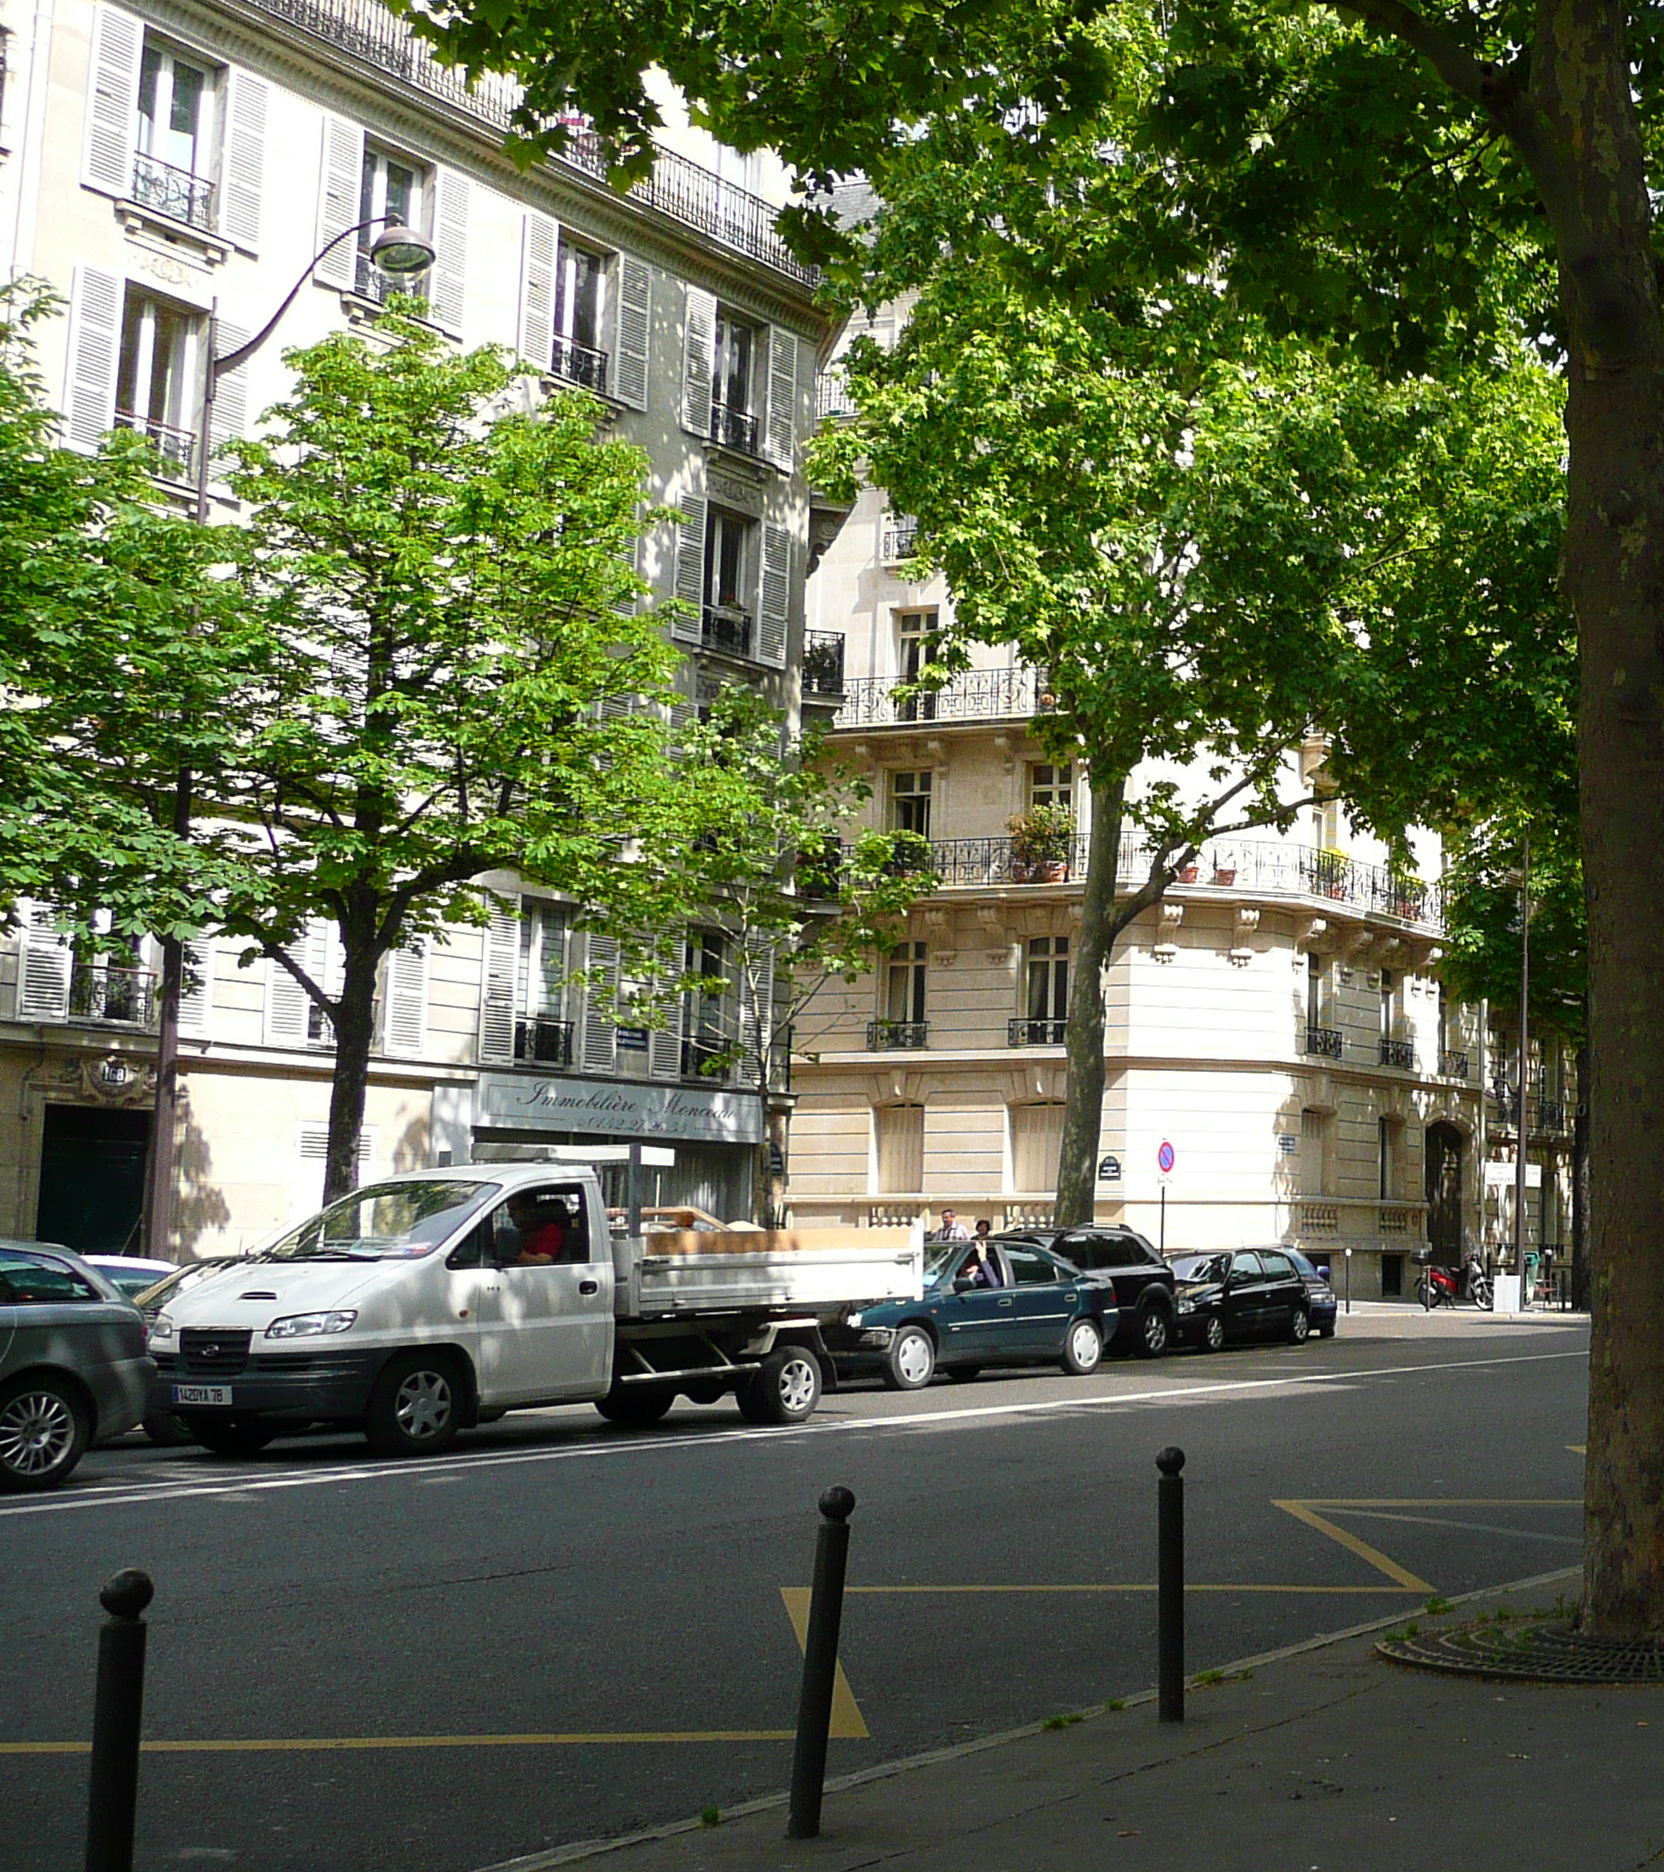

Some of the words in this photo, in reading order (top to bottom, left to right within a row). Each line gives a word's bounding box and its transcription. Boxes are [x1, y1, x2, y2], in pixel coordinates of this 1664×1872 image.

[104, 1066, 125, 1081] 168
[516, 1081, 637, 1112] Immobilière
[648, 1092, 736, 1120] Monceau
